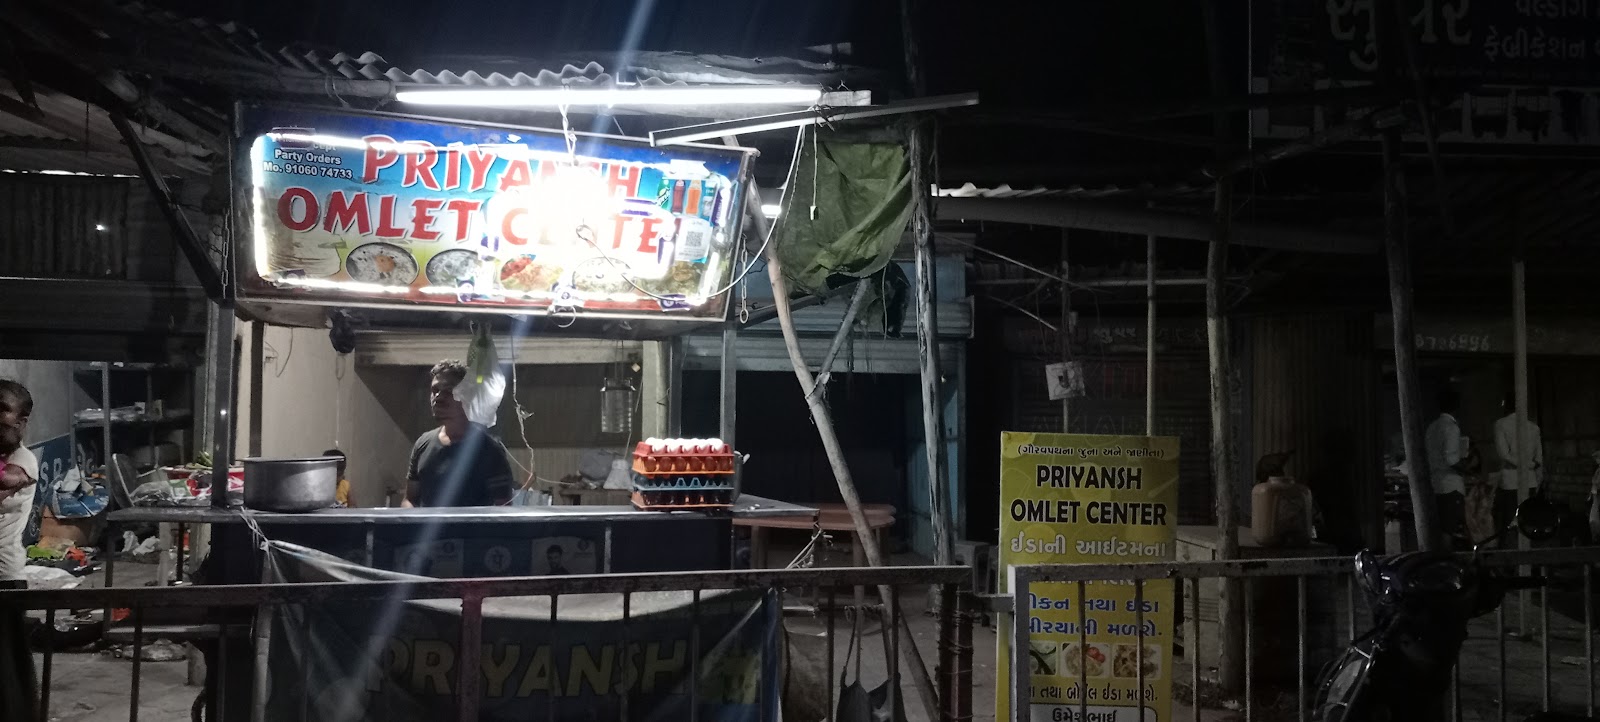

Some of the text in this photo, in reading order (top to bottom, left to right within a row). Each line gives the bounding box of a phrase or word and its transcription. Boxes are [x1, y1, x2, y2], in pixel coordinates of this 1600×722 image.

[274, 149, 341, 164] Party Orders
[362, 135, 641, 200] PRIYAH
[263, 161, 353, 179] Mo. 91060 74733
[277, 187, 481, 243] OMLET
[1103, 445, 1122, 456] અને
[1036, 465, 1142, 490] PRIYANSH
[1011, 499, 1167, 526] OMLET CENTER
[366, 634, 688, 698] PRYANSH
